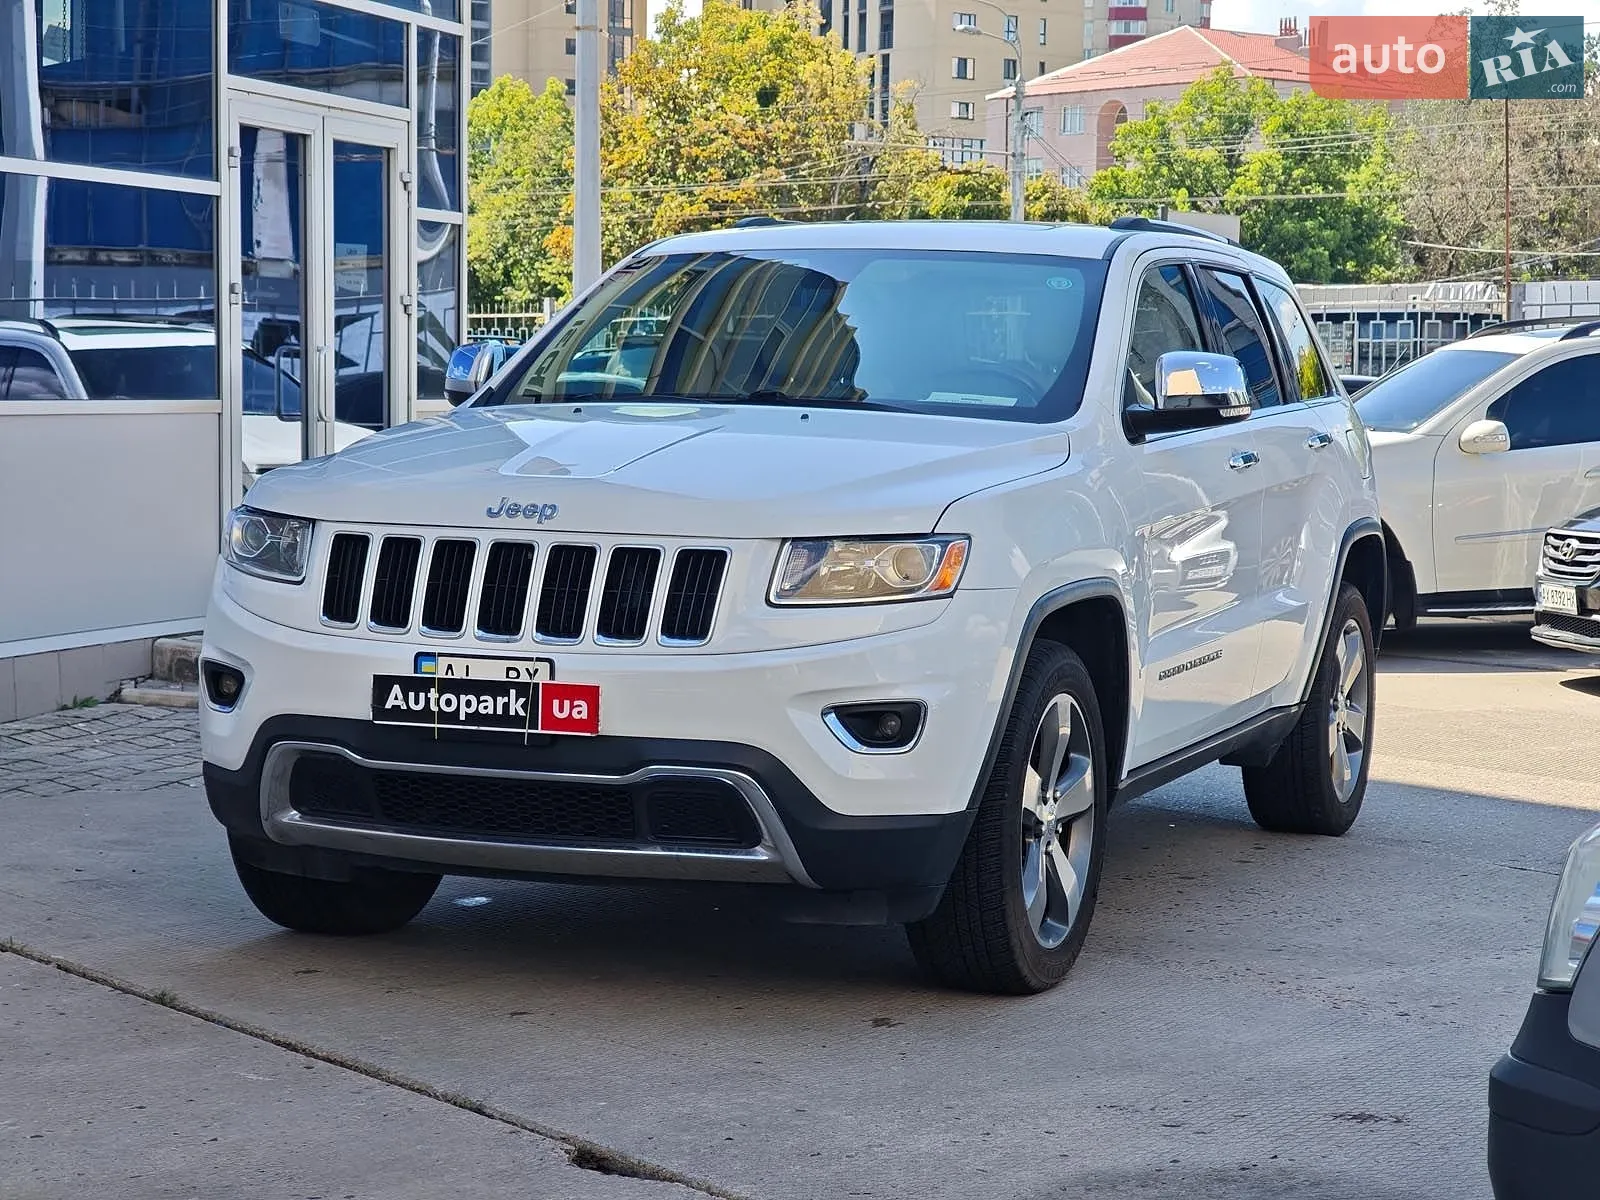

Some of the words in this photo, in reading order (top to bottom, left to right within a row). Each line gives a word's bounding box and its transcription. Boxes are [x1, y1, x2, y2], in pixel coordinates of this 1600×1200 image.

[486, 497, 559, 525] Jeep
[384, 684, 527, 720] Autopark
[552, 698, 588, 720] ua
